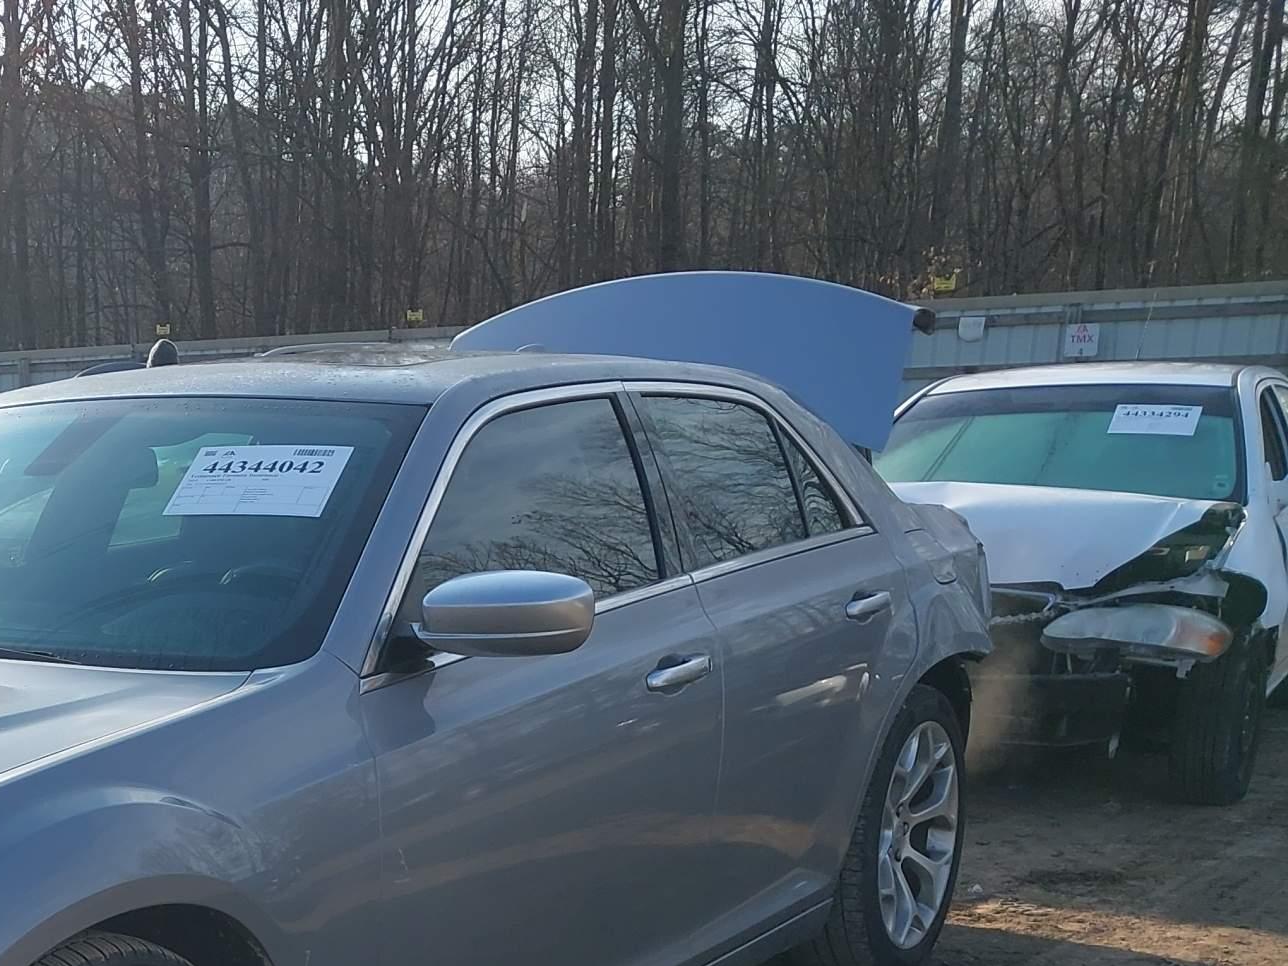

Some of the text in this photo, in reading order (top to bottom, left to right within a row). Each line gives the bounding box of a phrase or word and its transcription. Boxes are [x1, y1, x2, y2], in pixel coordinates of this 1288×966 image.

[1071, 334, 1094, 343] TMX
[1122, 410, 1190, 418] 44334294
[202, 460, 325, 474] 44344042
